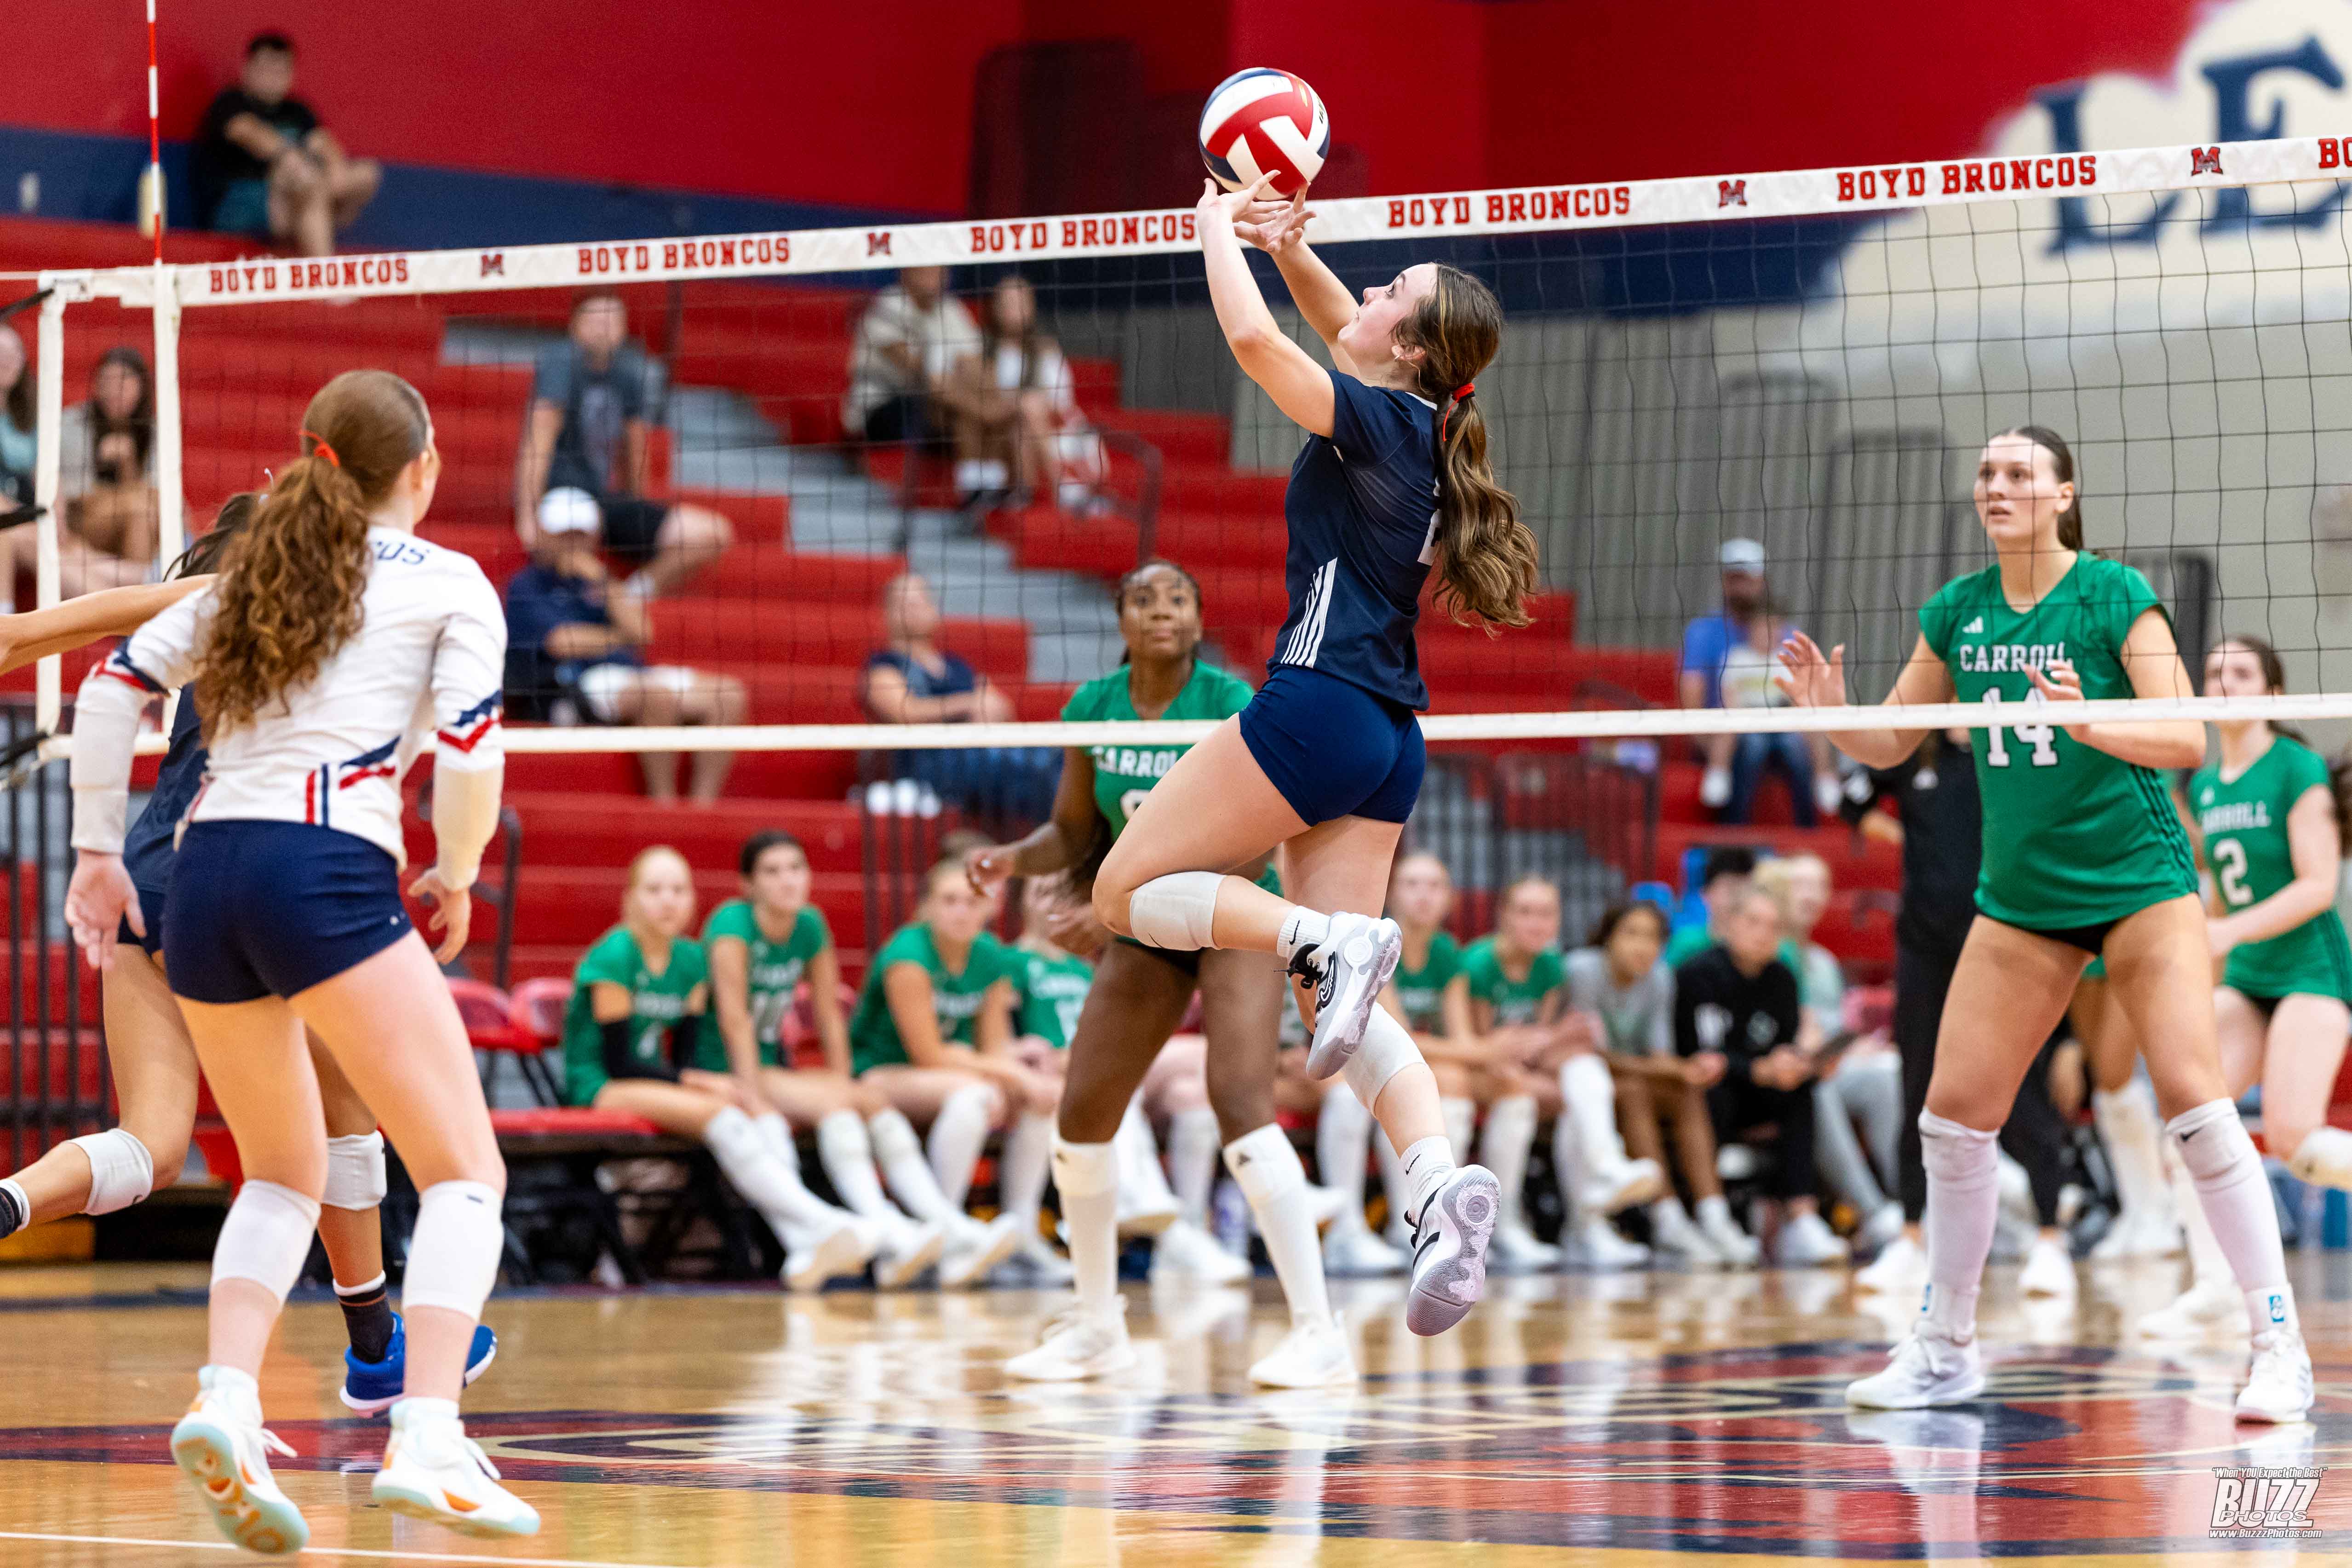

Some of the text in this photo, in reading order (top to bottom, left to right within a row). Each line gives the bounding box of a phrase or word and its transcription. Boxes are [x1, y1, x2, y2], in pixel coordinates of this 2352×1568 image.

[1837, 155, 2096, 201] BOYD BRONCOS
[1388, 186, 1630, 228] BOYD BRONCOS
[970, 214, 1196, 253] BOYD BRONCOS
[210, 258, 408, 293] BOYD BRONCOS
[578, 237, 790, 274] BOYD BRONCOS
[1982, 687, 2058, 767] 14
[2214, 838, 2253, 905] 2
